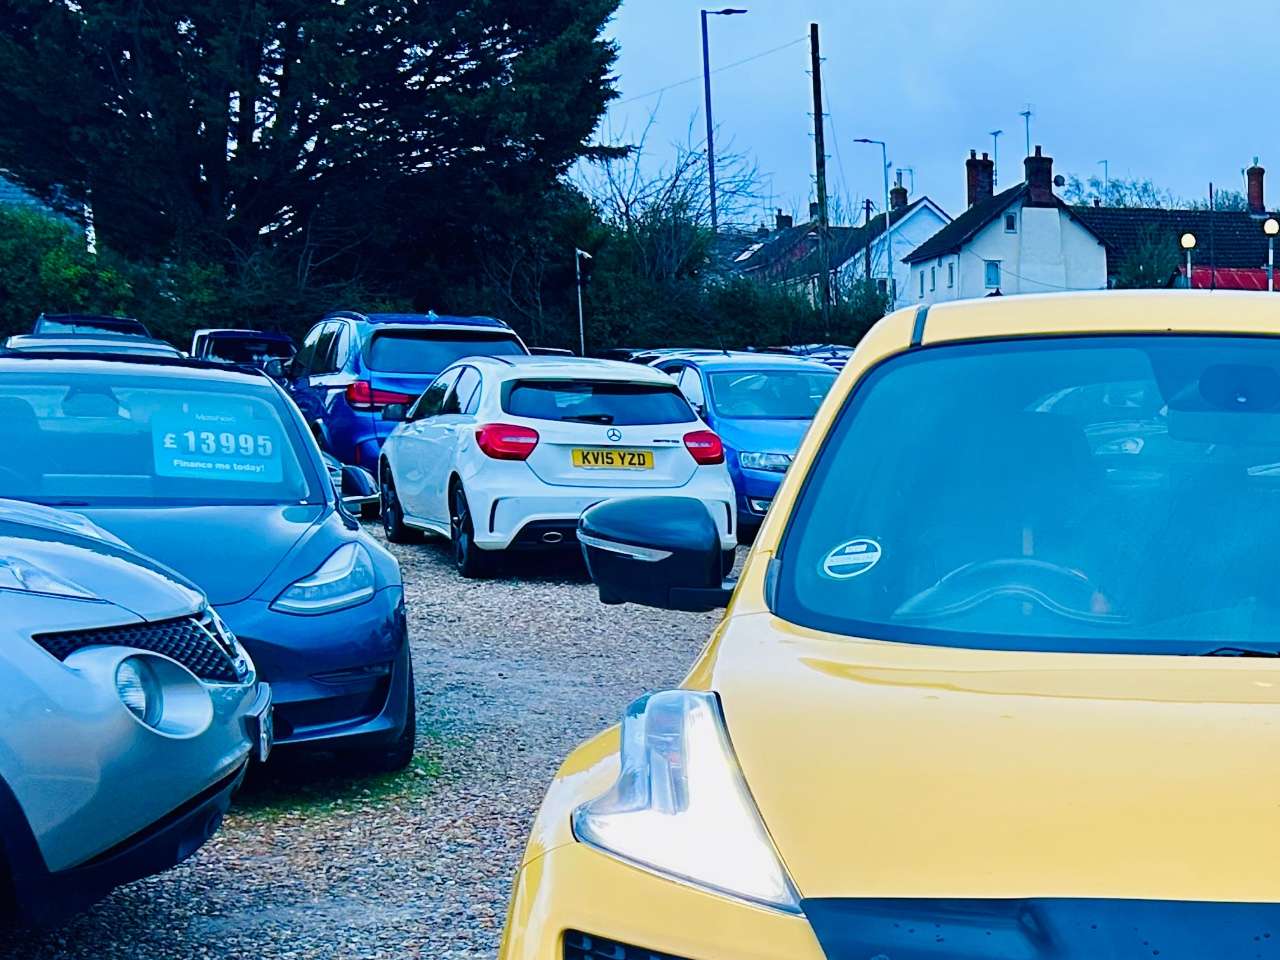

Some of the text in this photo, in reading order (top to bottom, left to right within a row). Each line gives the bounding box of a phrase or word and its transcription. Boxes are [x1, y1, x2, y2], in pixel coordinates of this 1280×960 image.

[173, 459, 213, 470] Finance
[215, 462, 231, 470] me
[581, 451, 646, 466] KV15 YZD
